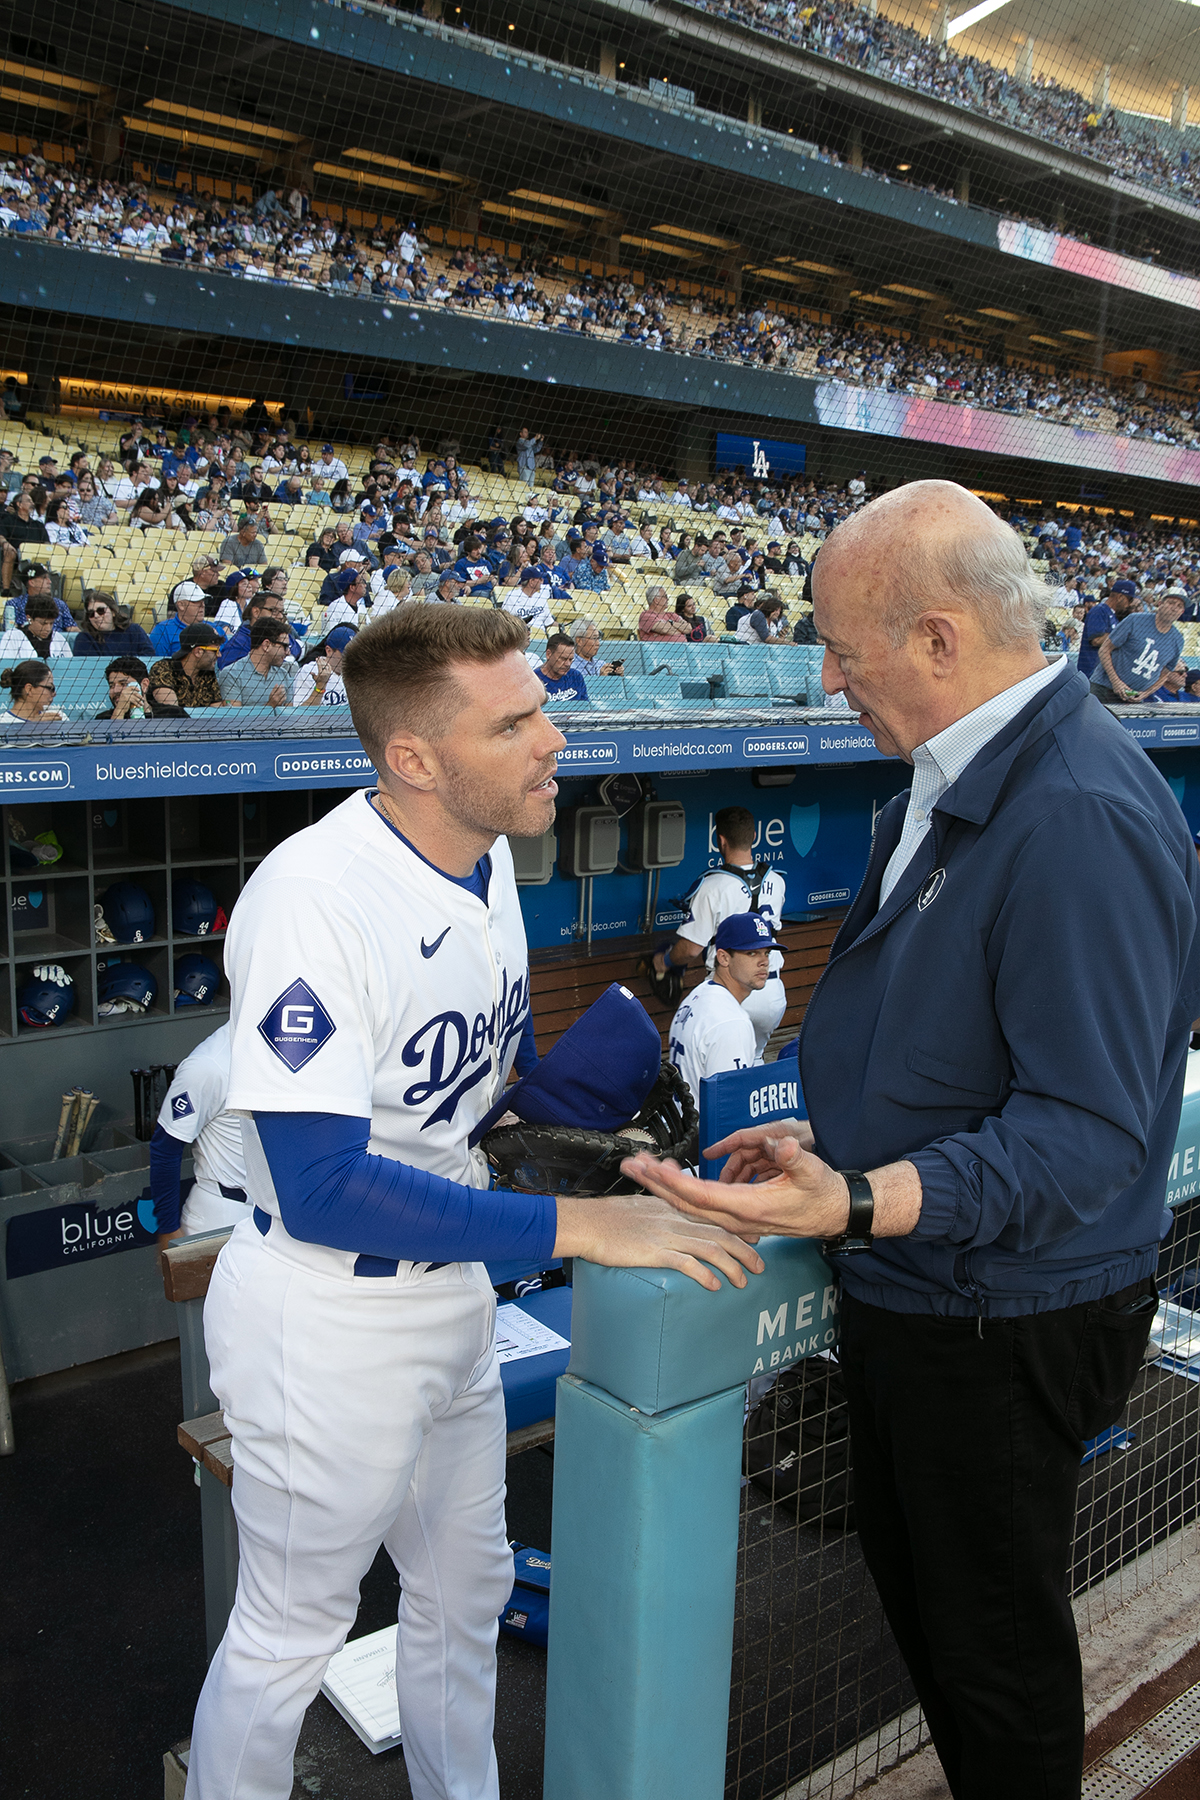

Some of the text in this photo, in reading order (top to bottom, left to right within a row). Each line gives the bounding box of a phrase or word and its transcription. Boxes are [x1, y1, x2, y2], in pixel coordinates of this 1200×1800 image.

[70, 386, 208, 411] ELYSIAN PARK GRILL
[752, 441, 770, 479] LA
[1131, 637, 1160, 681] LA
[1163, 728, 1197, 737] DODGERS.COM
[632, 742, 733, 758] blueshieldca.com
[748, 741, 805, 752] DODGERS.COM
[96, 761, 257, 781] blueshieldca.com
[282, 758, 372, 772] DODGERS.COM
[708, 812, 785, 853] bue
[708, 851, 784, 868] CARNIA
[741, 881, 773, 899] STH
[810, 890, 847, 902] DODGERS.COM
[135, 930, 142, 938] 6
[199, 922, 209, 930] 44
[753, 918, 770, 937] LA
[199, 985, 208, 995] 16
[281, 1005, 314, 1034] G
[274, 1036, 318, 1044] GUGGENHEIM
[175, 1097, 189, 1111] G
[749, 1082, 799, 1118] GEREN
[1167, 1145, 1200, 1182] ME
[1166, 1180, 1197, 1204] BANK
[61, 1211, 134, 1245] blue
[63, 1232, 135, 1255] CALIFORNIA
[752, 1357, 765, 1375] A
[769, 1333, 820, 1368] BANK
[353, 1645, 388, 1663] LEHMANN
